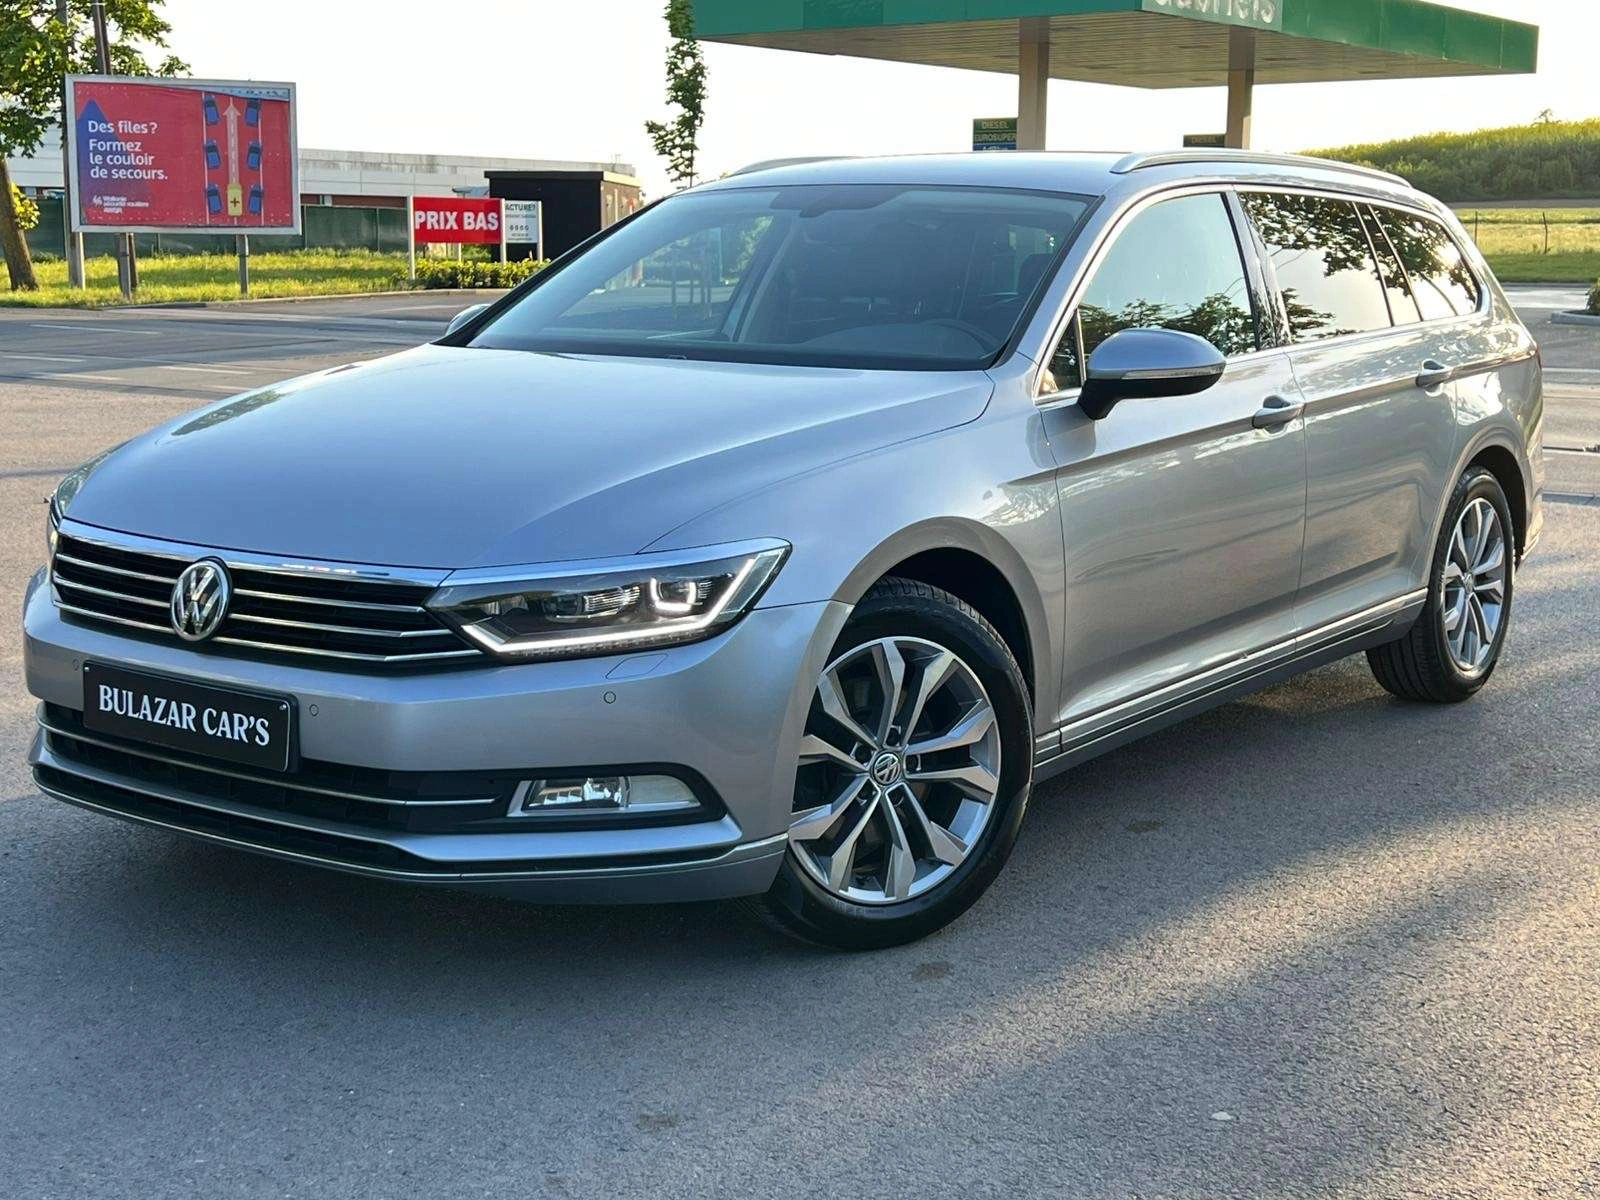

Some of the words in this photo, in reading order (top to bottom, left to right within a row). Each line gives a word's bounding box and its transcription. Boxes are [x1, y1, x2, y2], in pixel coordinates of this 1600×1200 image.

[88, 120, 115, 133] Des
[89, 139, 142, 151] Formez
[89, 152, 103, 165] le
[106, 153, 155, 165] couloir
[90, 166, 108, 178] de
[111, 168, 168, 180] secours.
[415, 210, 459, 230] PRIX
[462, 211, 499, 231] BAS
[98, 684, 197, 732] BULAZAR
[202, 707, 270, 747] CAR'S
